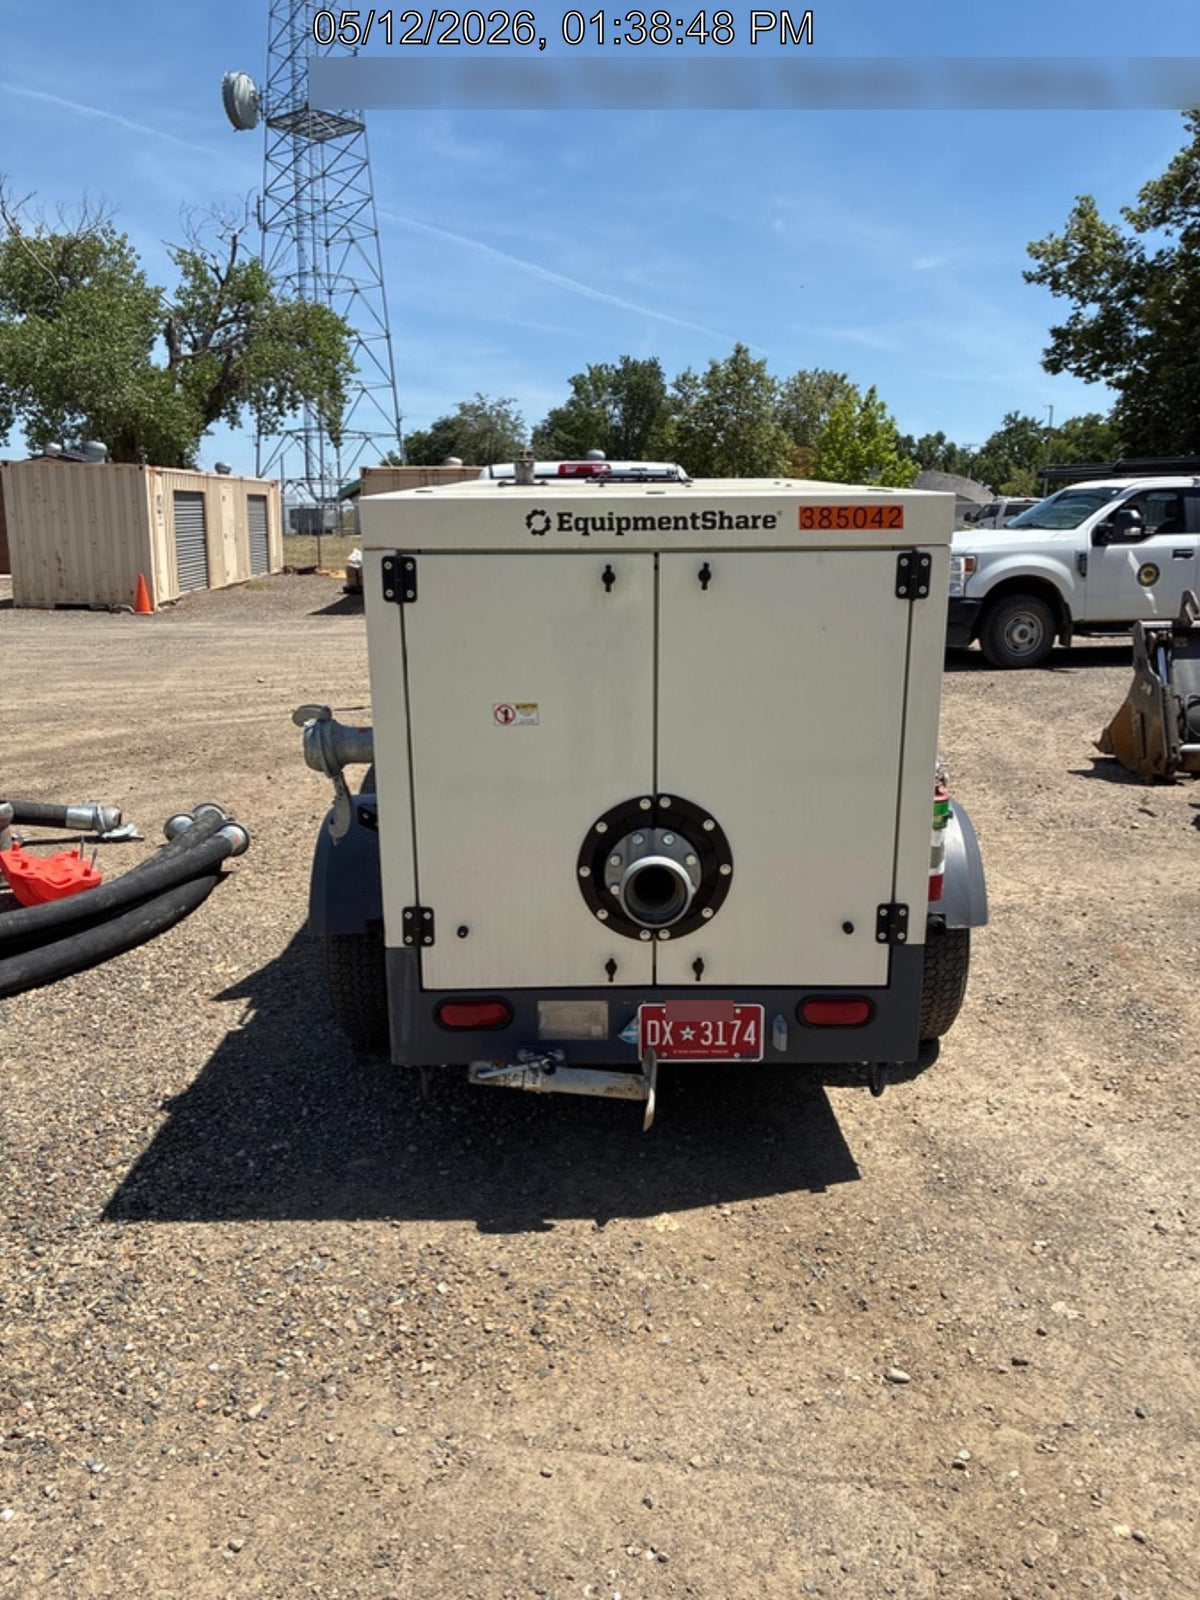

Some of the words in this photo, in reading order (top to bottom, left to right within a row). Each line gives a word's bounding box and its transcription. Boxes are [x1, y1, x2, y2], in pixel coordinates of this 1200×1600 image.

[557, 510, 778, 535] EquipmentShare
[802, 506, 903, 529] 385042
[646, 1020, 674, 1046] DX
[700, 1020, 756, 1046] 3174
